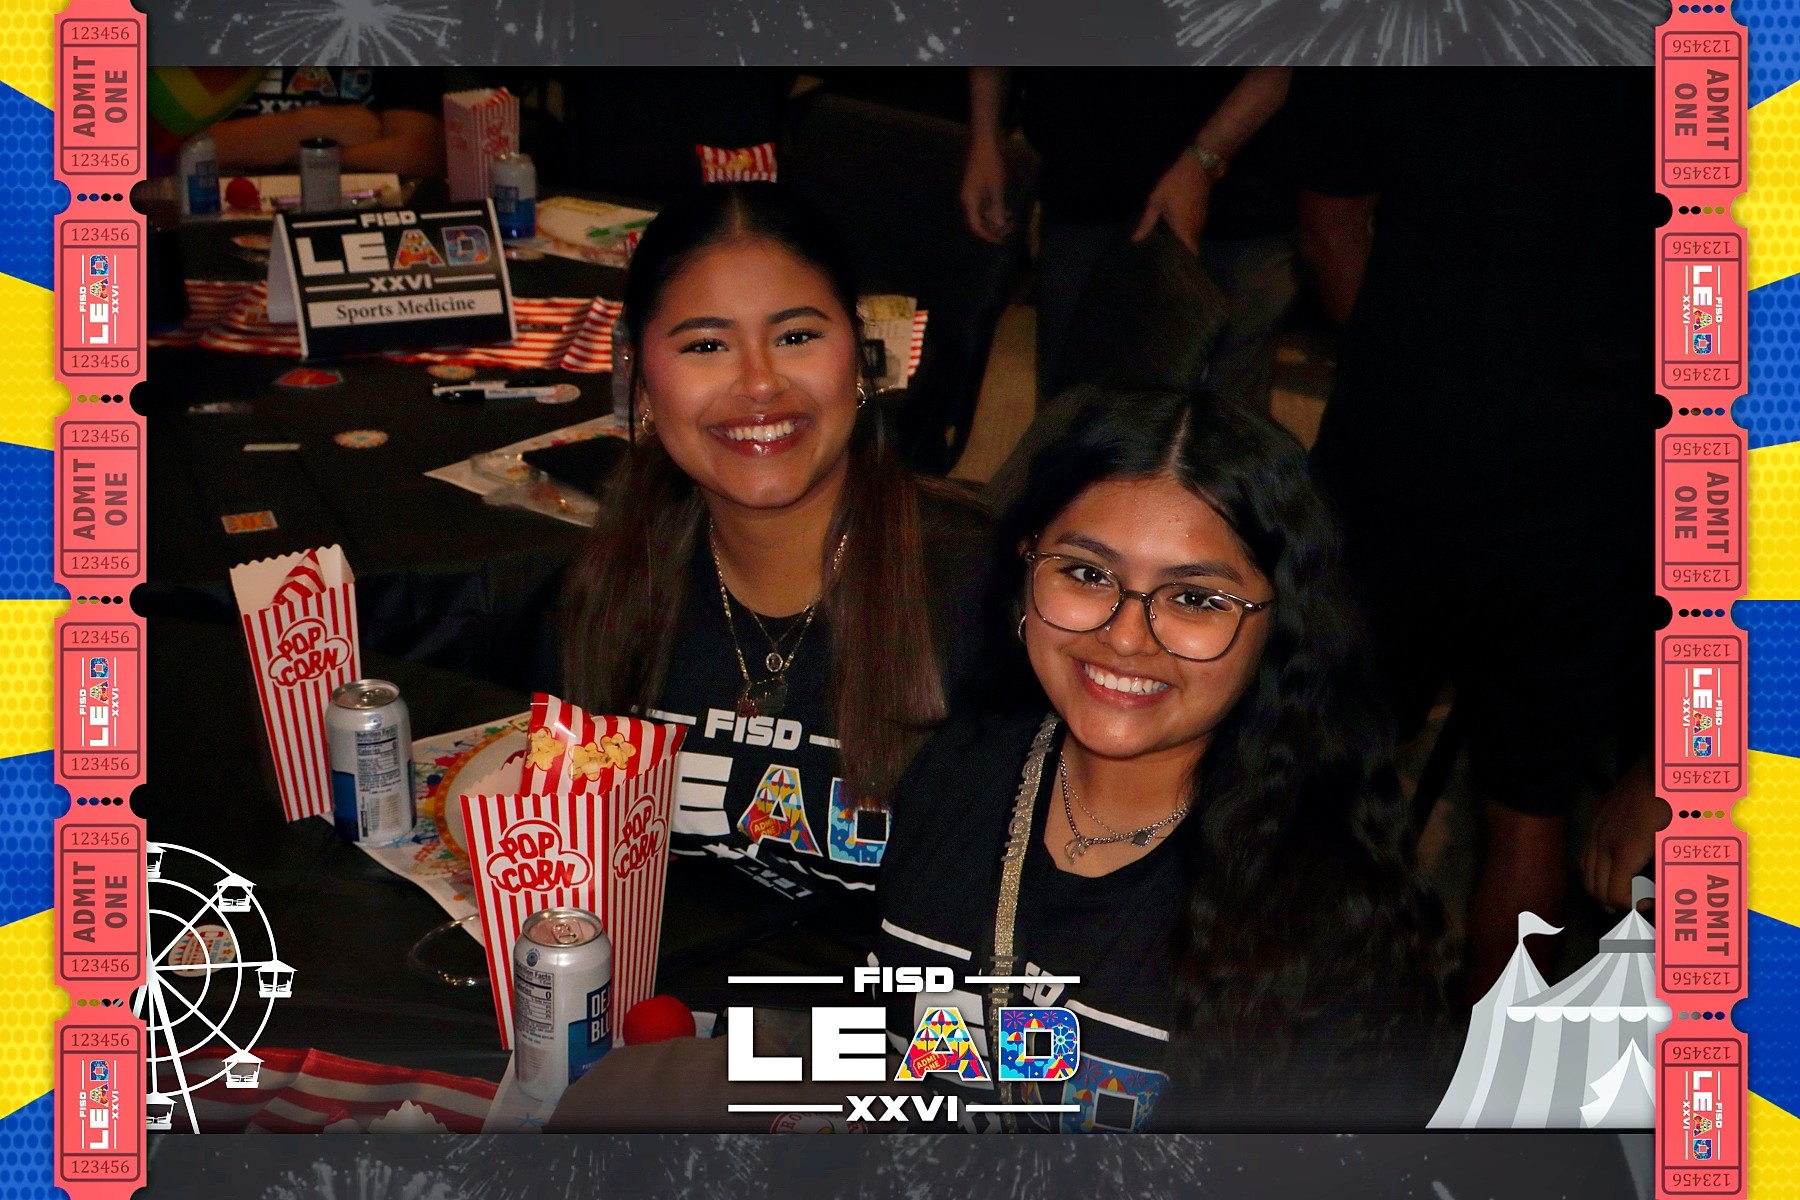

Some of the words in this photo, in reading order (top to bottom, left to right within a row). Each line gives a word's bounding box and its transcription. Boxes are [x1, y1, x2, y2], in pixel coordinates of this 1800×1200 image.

[360, 210, 417, 228] FISD
[295, 225, 492, 277] LEAD
[369, 274, 433, 293] XXVI
[336, 301, 393, 323] Sports
[398, 296, 476, 316] Medicine
[277, 627, 321, 662] POP
[281, 647, 338, 686] CORN
[704, 708, 803, 751] FISD
[622, 805, 650, 847] POP
[671, 750, 893, 867] EAD
[499, 832, 555, 864] POP
[617, 829, 660, 878] CORN
[501, 859, 576, 893] CORN
